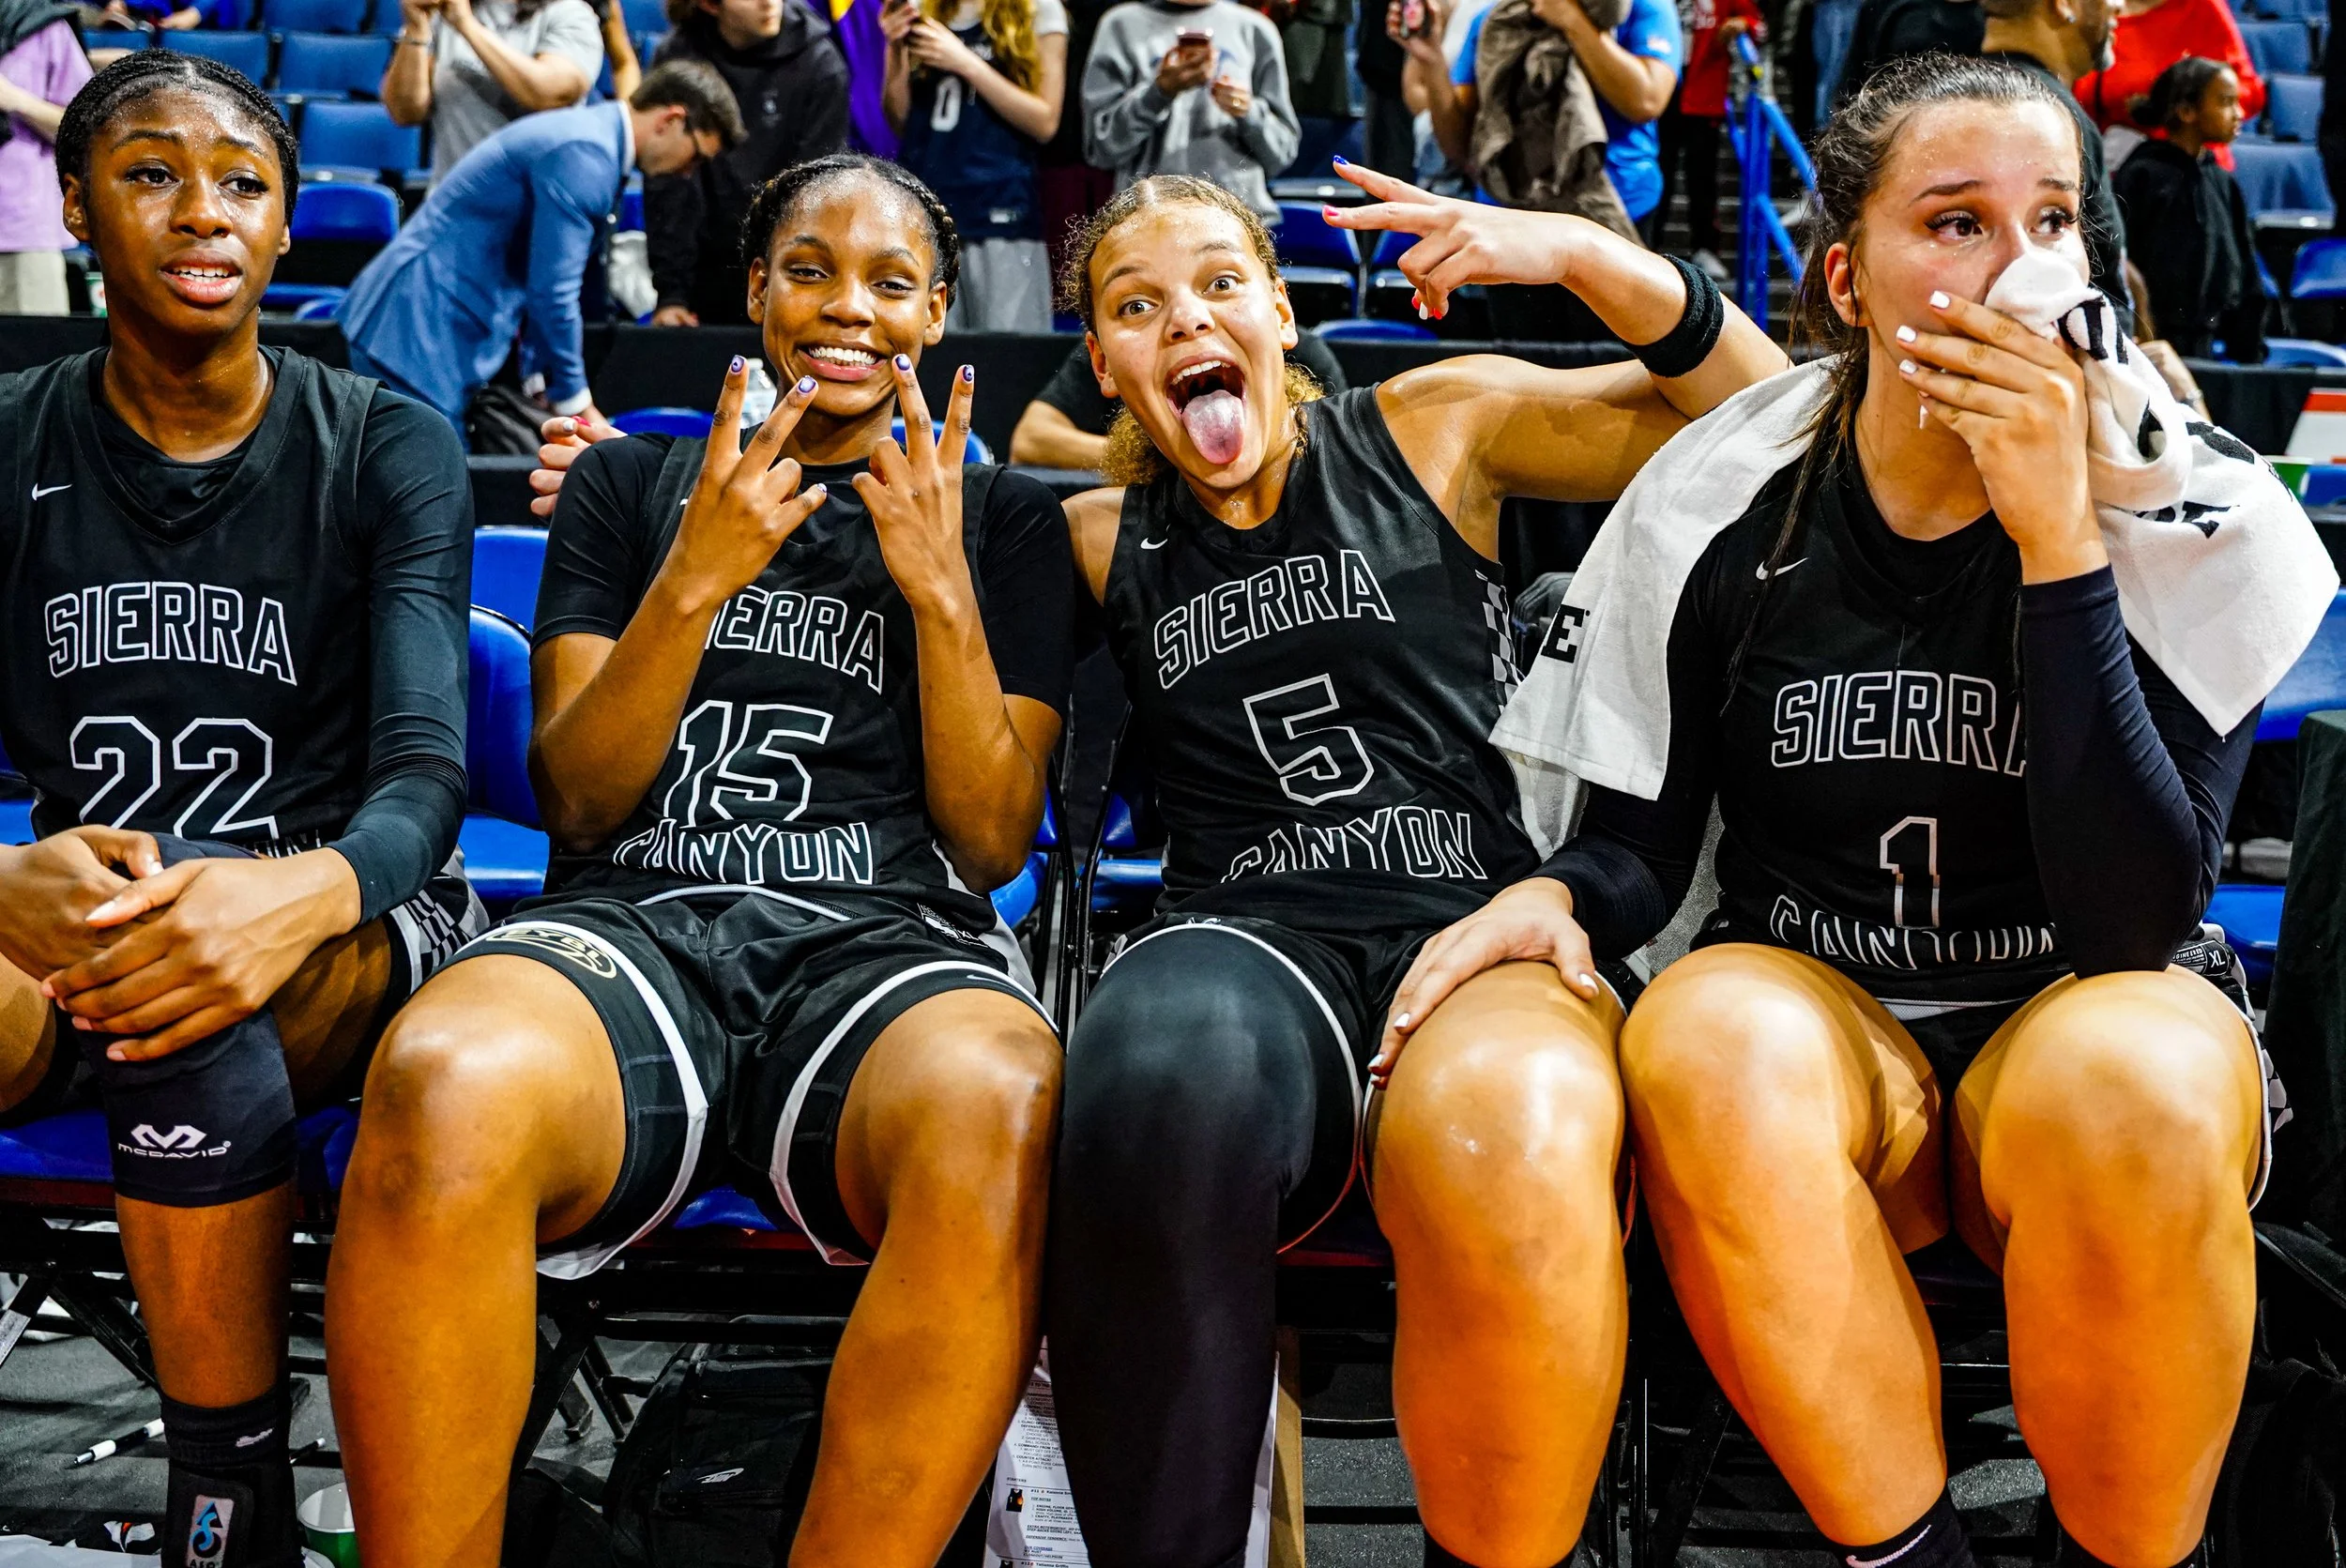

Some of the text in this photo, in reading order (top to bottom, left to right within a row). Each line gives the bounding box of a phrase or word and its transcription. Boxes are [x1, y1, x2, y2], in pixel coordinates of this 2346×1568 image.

[44, 581, 297, 686] SIERRA
[1154, 549, 1396, 690] SIERRA
[69, 716, 280, 840] 22
[663, 699, 834, 830] 15
[1242, 673, 1375, 806] 5
[613, 818, 874, 886] CANYON
[1220, 805, 1488, 884] CANYON
[1880, 815, 1941, 929] 1
[2208, 950, 2226, 968] XL
